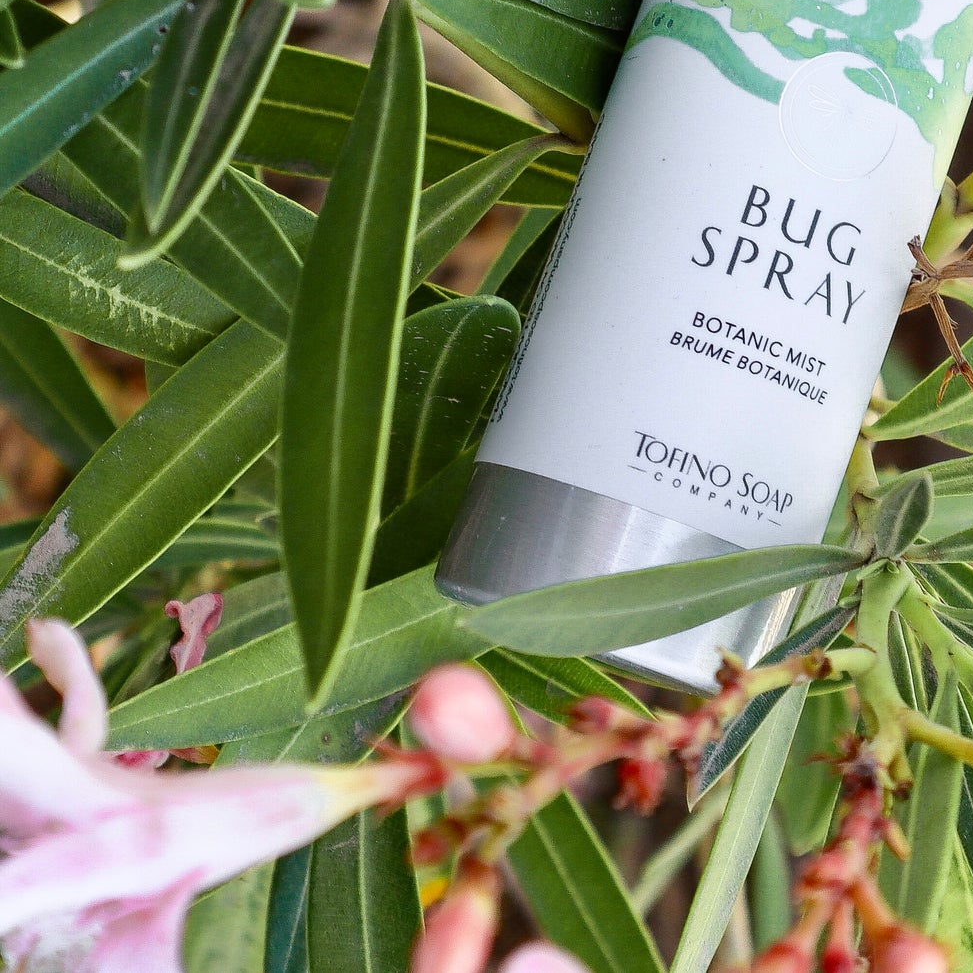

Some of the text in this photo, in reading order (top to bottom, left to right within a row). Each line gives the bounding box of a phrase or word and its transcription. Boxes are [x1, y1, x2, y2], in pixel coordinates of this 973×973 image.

[740, 184, 862, 267] BUG
[691, 226, 866, 325] SPRAY
[669, 331, 828, 405] BRUME BOTANIQUE
[692, 311, 826, 377] BOTANIC MIST
[634, 430, 793, 514] TOFINO SOAP
[653, 471, 764, 520] COMPANY
